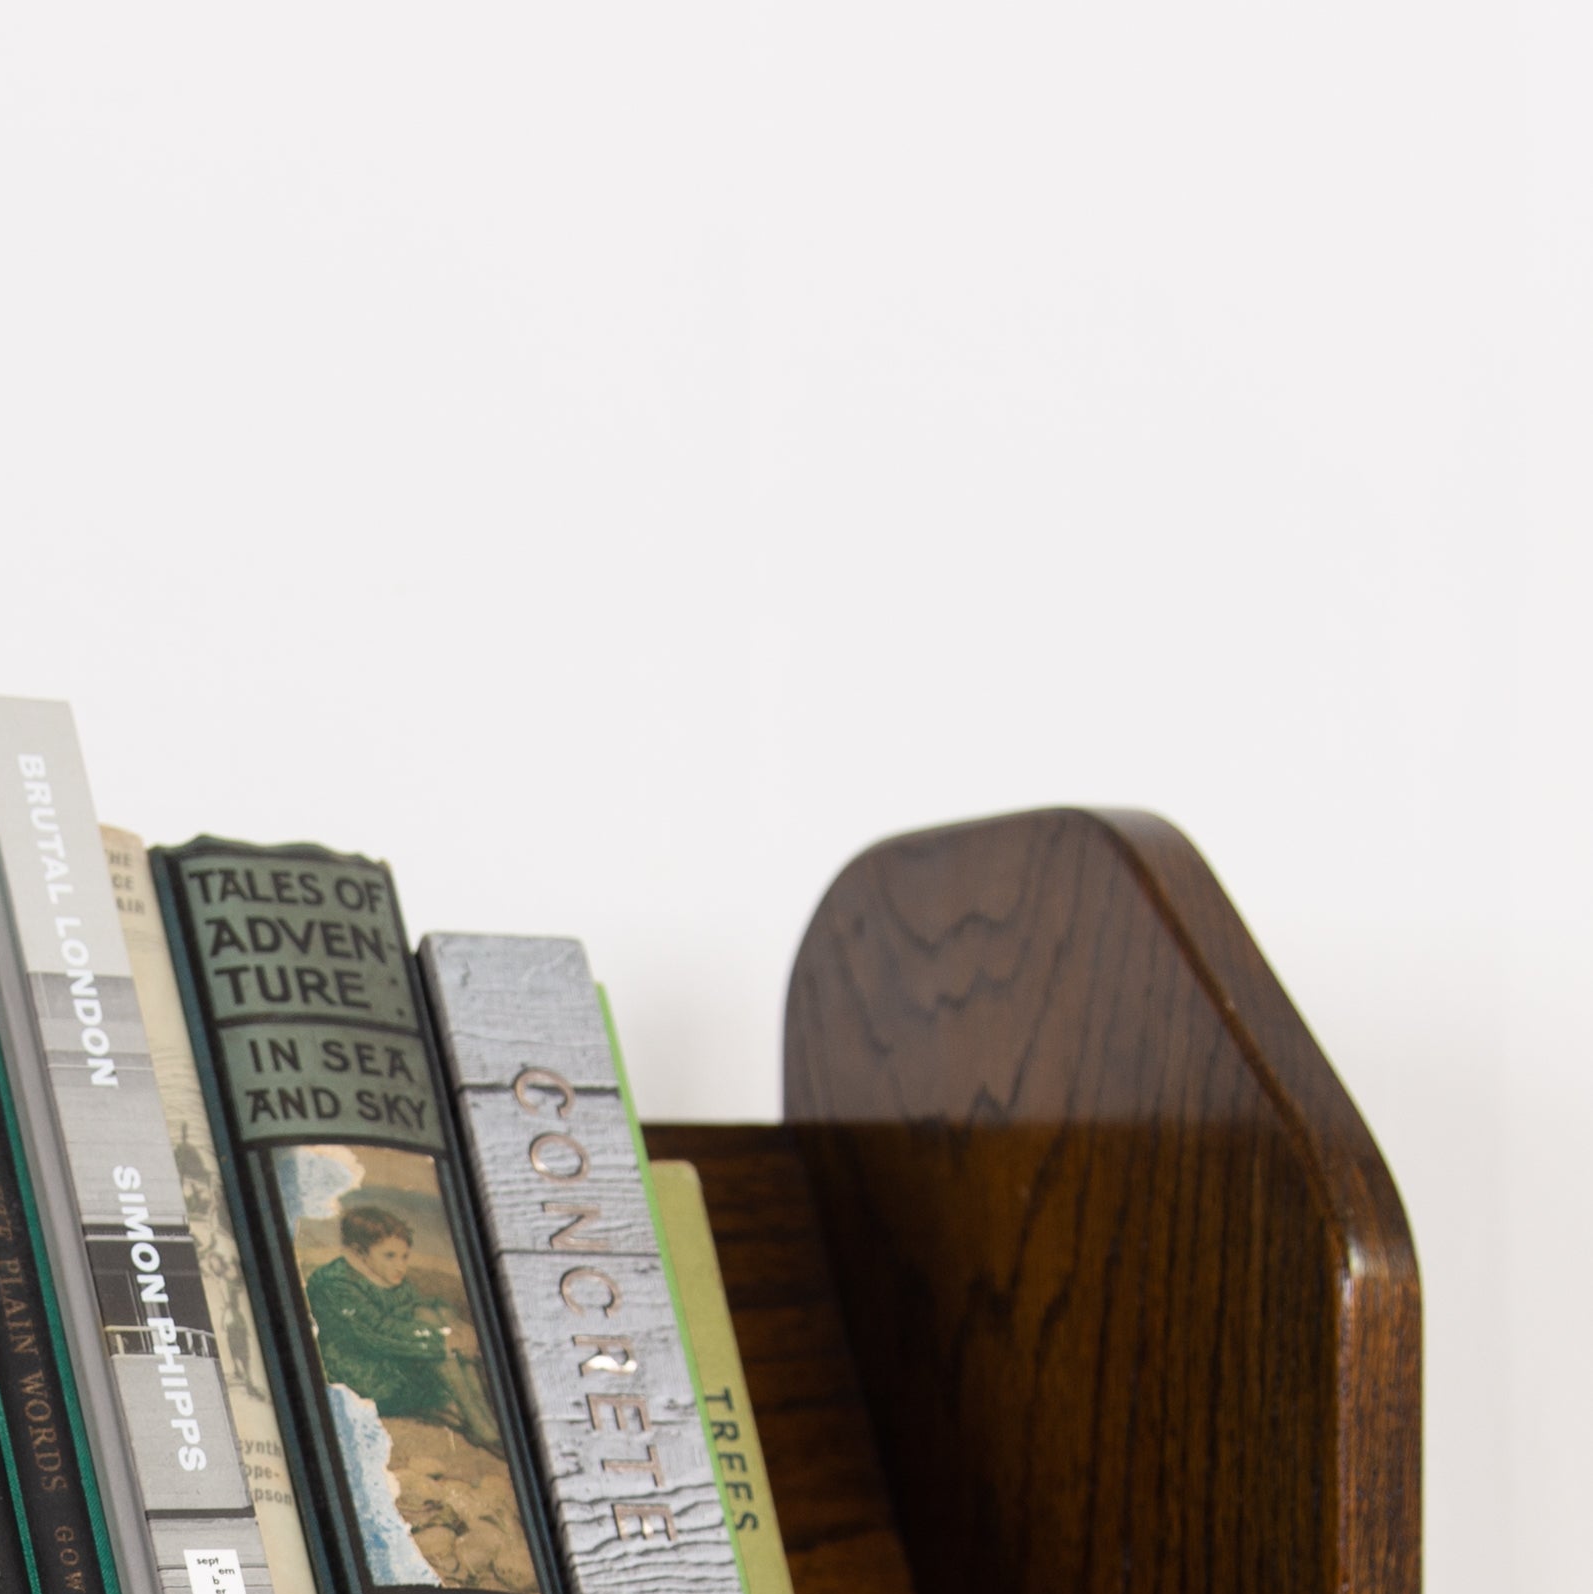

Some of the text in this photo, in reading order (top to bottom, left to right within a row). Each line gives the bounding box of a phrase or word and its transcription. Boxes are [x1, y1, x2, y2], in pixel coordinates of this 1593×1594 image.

[105, 849, 133, 866] HE
[189, 867, 387, 914] TALES OF
[17, 753, 120, 1089] BRUTAL LONDON
[248, 1038, 416, 1083] IN SEA
[245, 1086, 427, 1130] AND SKY
[112, 1165, 207, 1473] SIMON PHIPPS
[513, 1066, 679, 1544] CONCRETE
[19, 1369, 69, 1493] WORDS
[704, 1387, 759, 1532] TREES
[196, 1557, 220, 1567] sept
[212, 1575, 220, 1585] b
